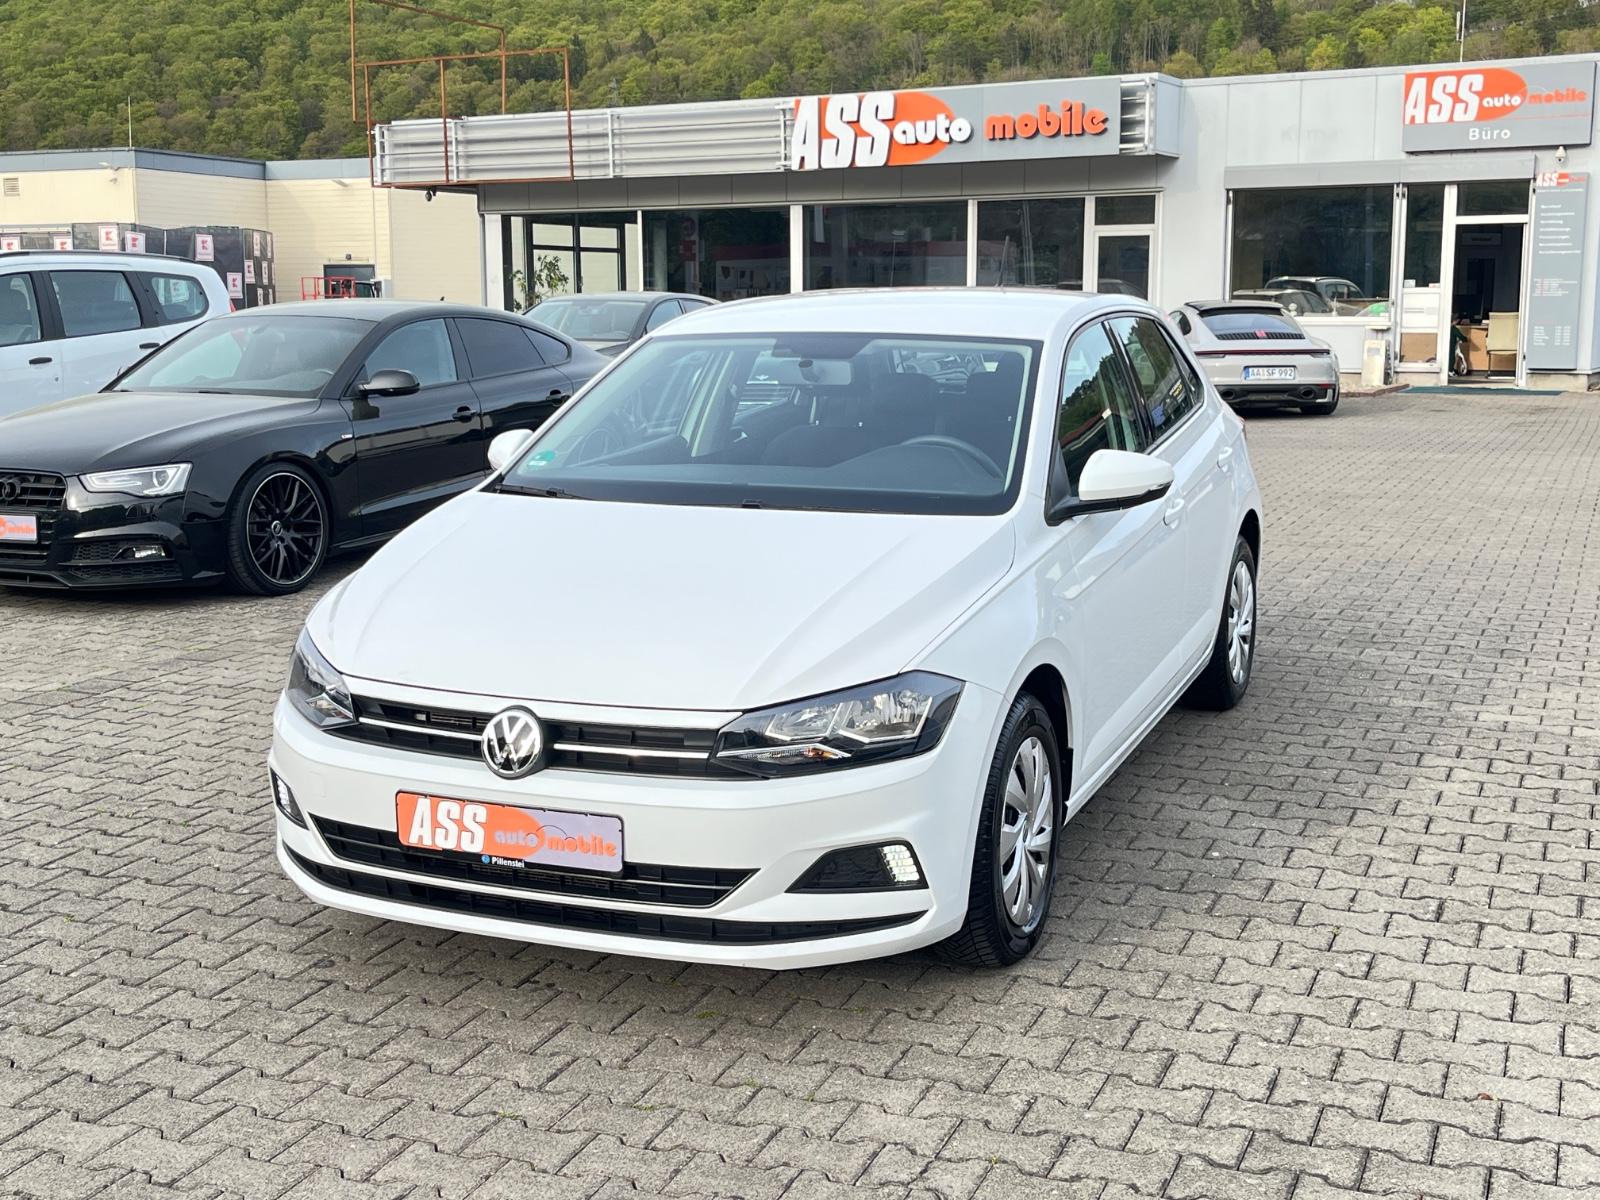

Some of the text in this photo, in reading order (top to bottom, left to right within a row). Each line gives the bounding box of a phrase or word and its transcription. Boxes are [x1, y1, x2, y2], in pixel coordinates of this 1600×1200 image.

[1404, 74, 1587, 125] ASS auto mobile
[791, 92, 1109, 170] ASS auto mobile
[1468, 127, 1511, 141] Büro
[1536, 172, 1558, 187] ASS
[1266, 368, 1276, 377] SF
[1278, 368, 1294, 377] 992
[408, 796, 617, 857] ASS auto mobile
